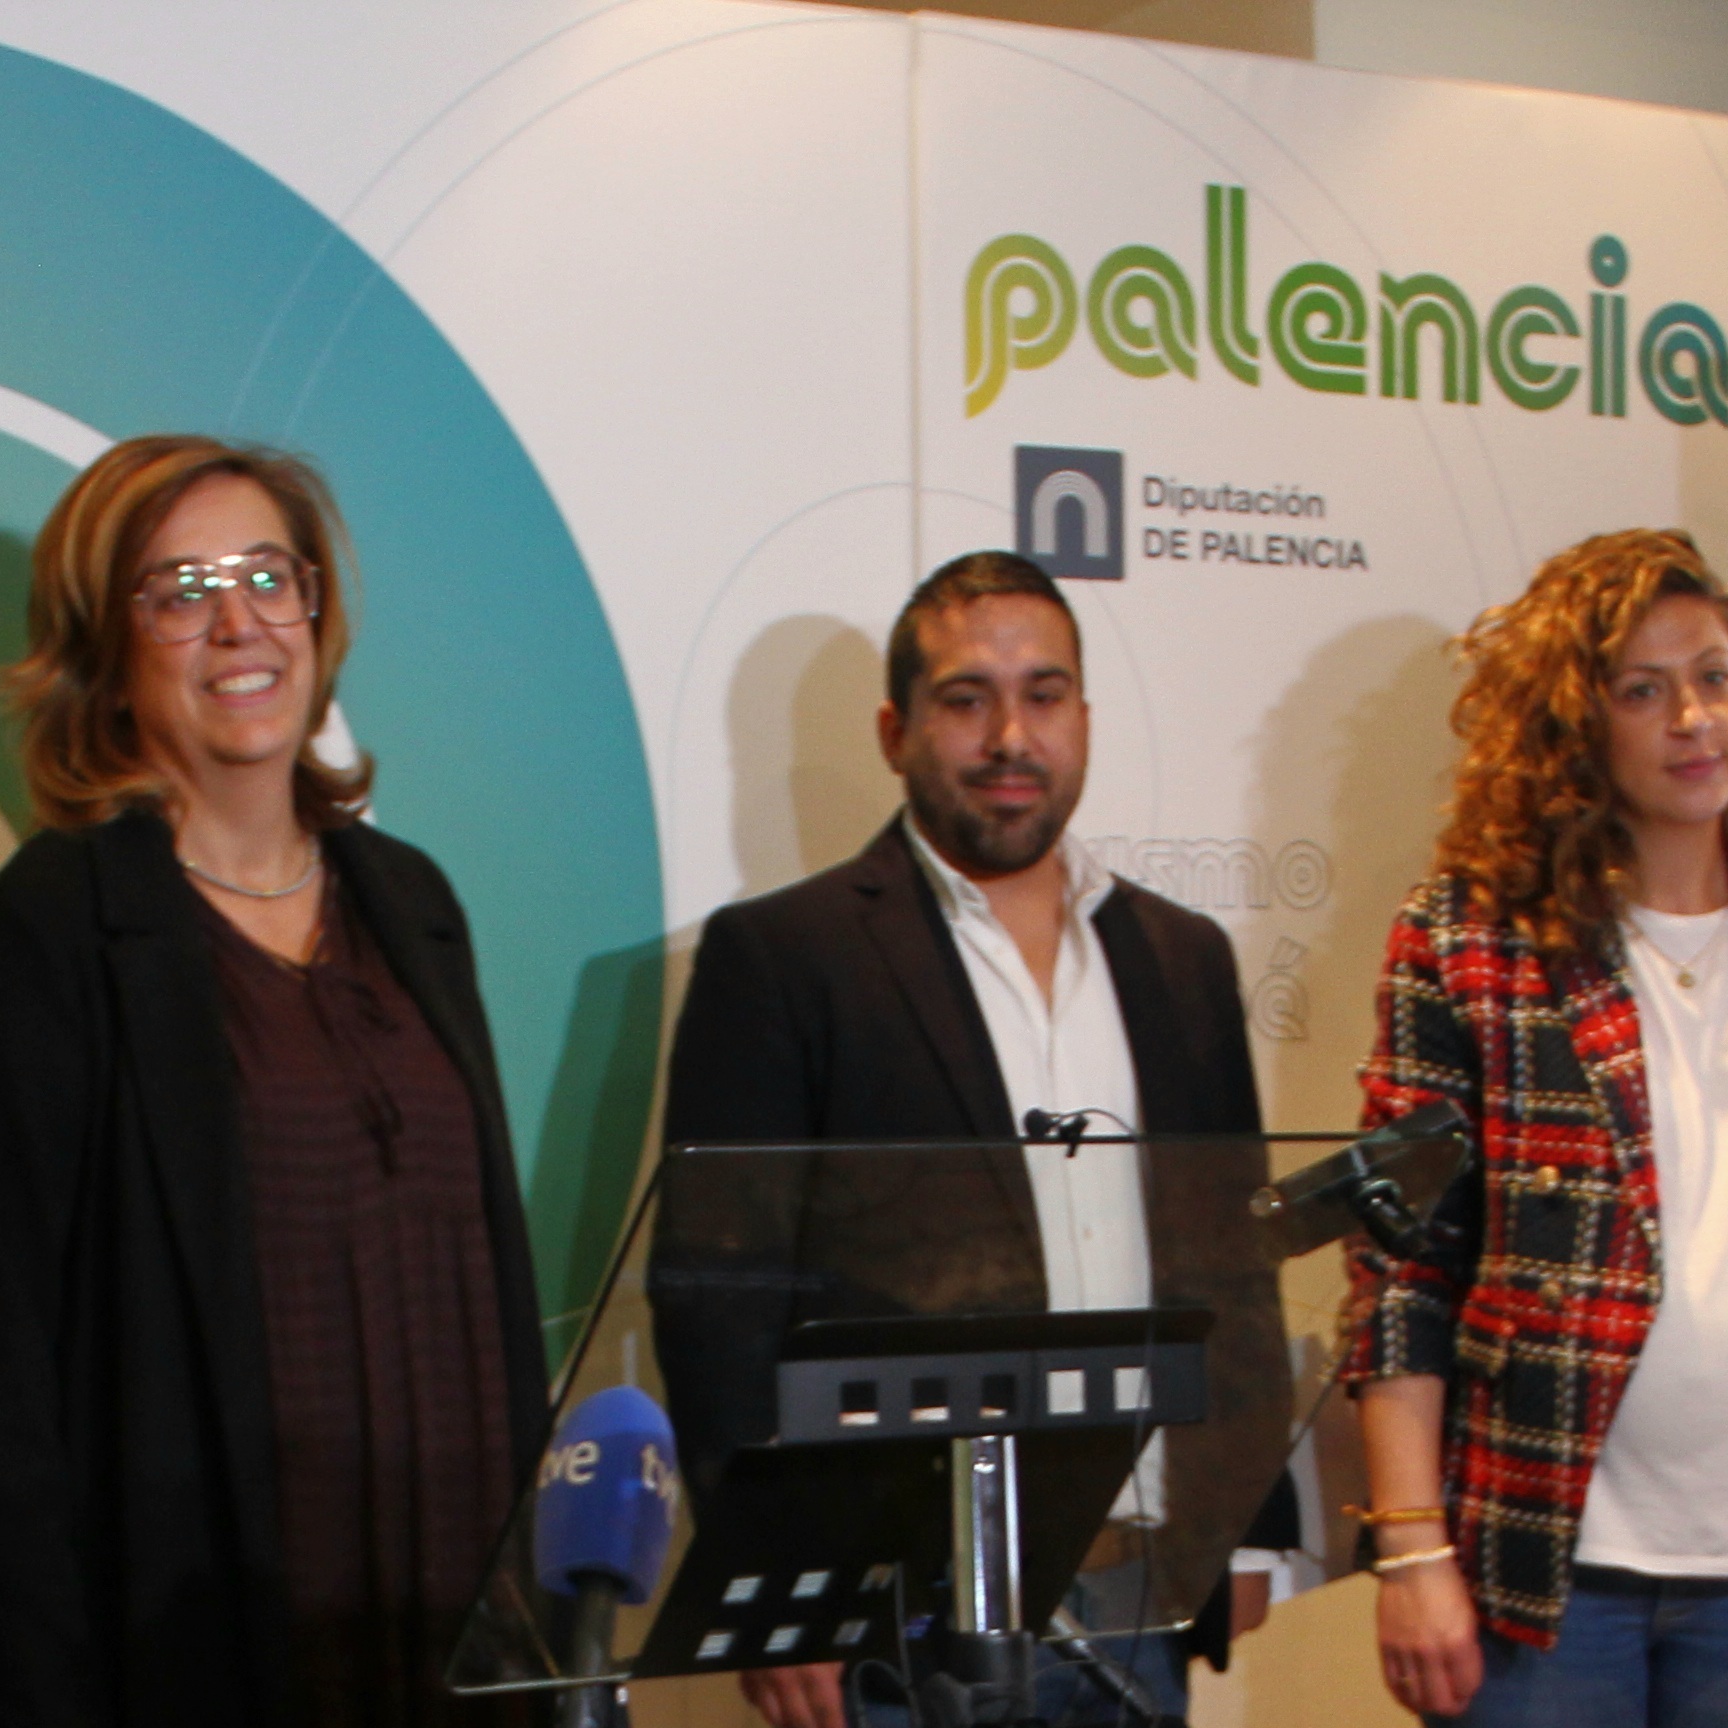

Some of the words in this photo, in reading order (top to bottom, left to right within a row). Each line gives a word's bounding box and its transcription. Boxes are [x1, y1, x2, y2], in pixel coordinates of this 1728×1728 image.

[1143, 473, 1326, 518] Diputación
[1143, 525, 1189, 559] DE
[1201, 529, 1368, 572] PALENCIA
